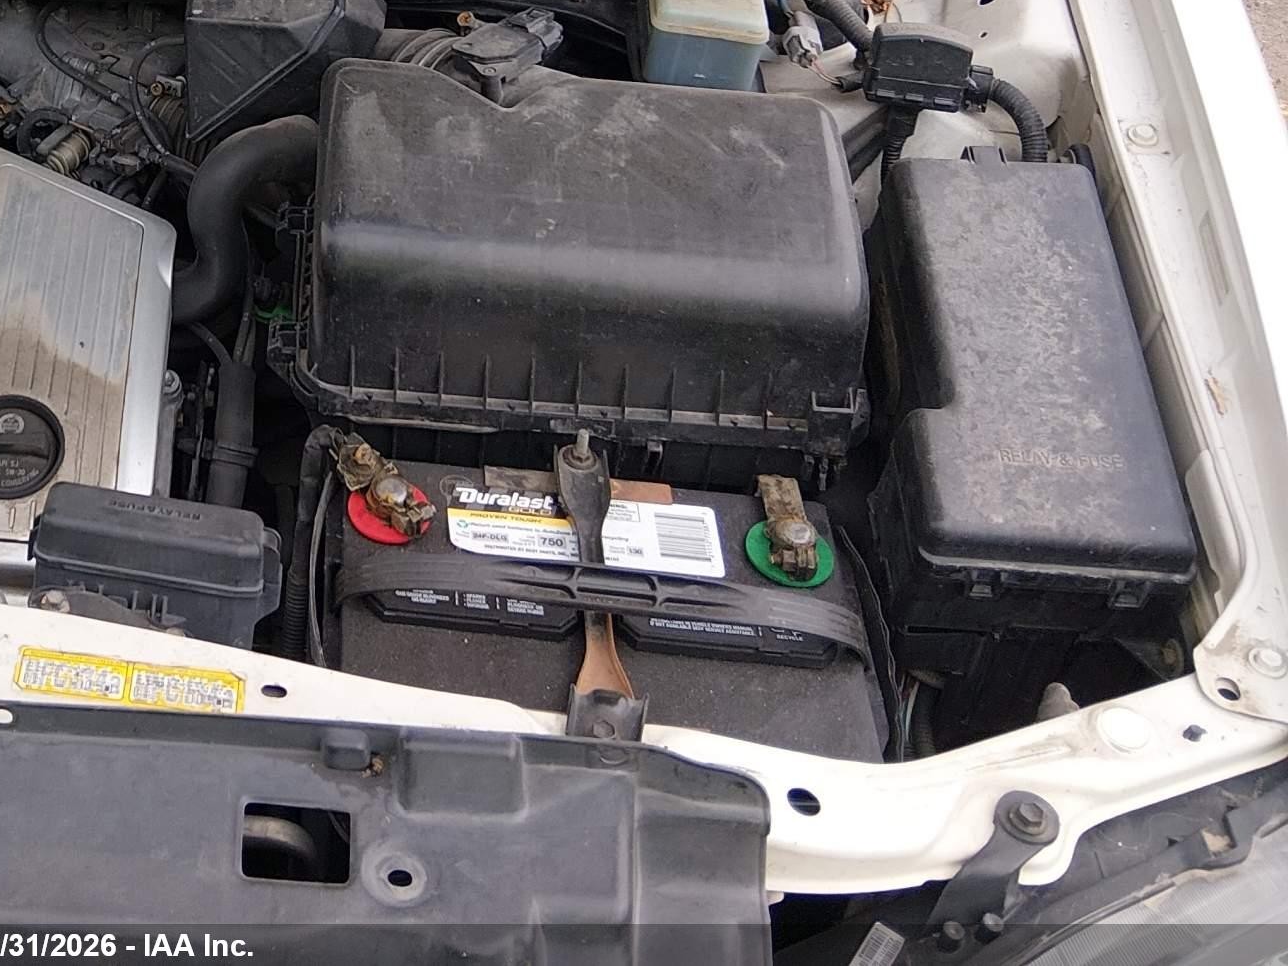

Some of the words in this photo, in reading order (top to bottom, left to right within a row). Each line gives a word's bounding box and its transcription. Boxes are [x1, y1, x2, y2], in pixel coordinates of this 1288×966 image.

[1079, 454, 1123, 468] FUSE
[455, 487, 554, 509] Duralast
[508, 507, 552, 515] GOLD
[541, 537, 563, 547] 750
